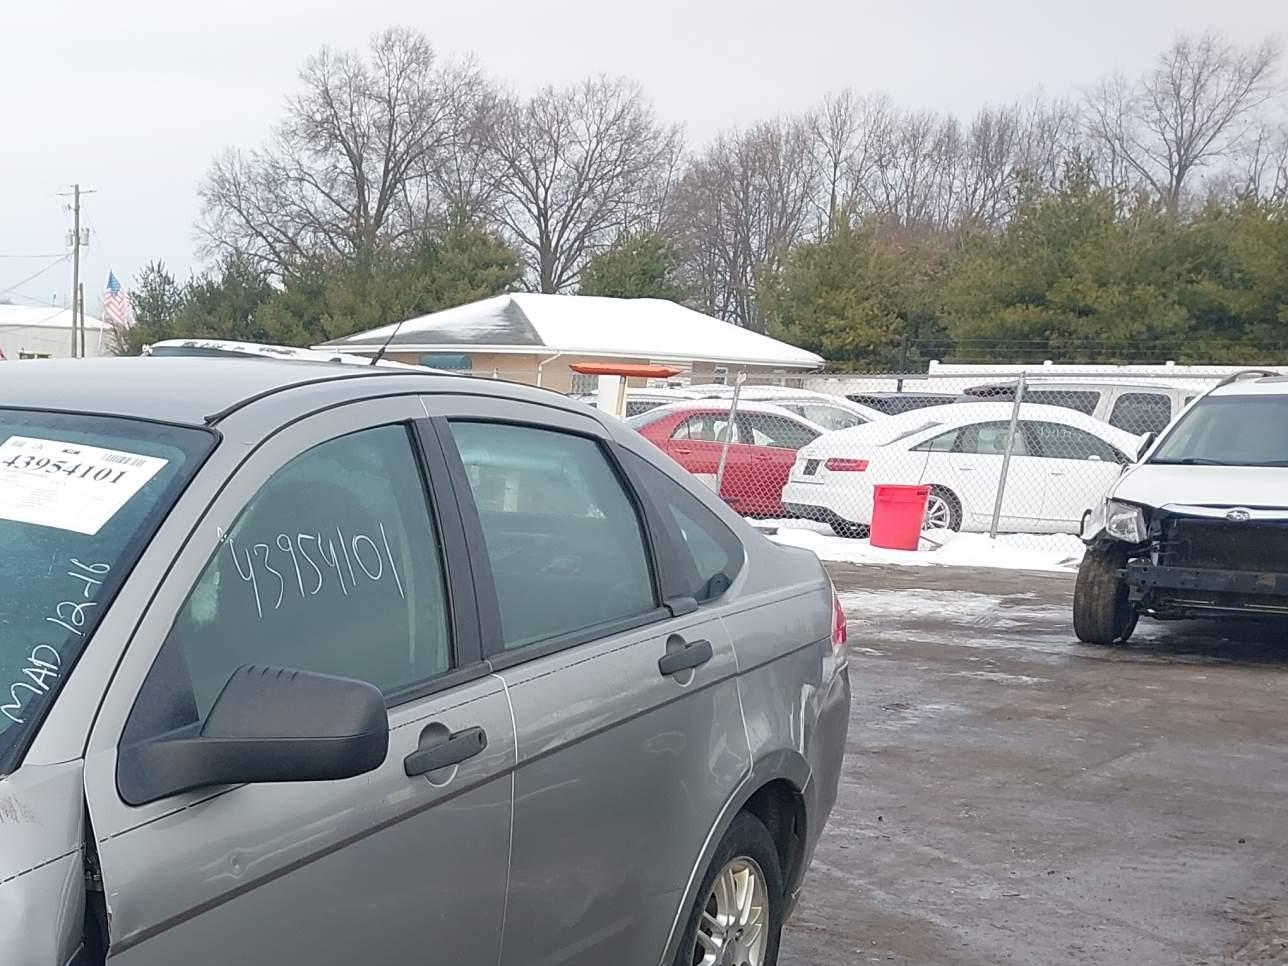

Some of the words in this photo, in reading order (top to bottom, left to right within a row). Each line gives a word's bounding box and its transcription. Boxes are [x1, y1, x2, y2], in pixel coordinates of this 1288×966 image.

[2, 453, 128, 484] 43954101
[229, 522, 405, 619] 43954101
[0, 644, 61, 723] MAD
[46, 558, 111, 636] 12-16
